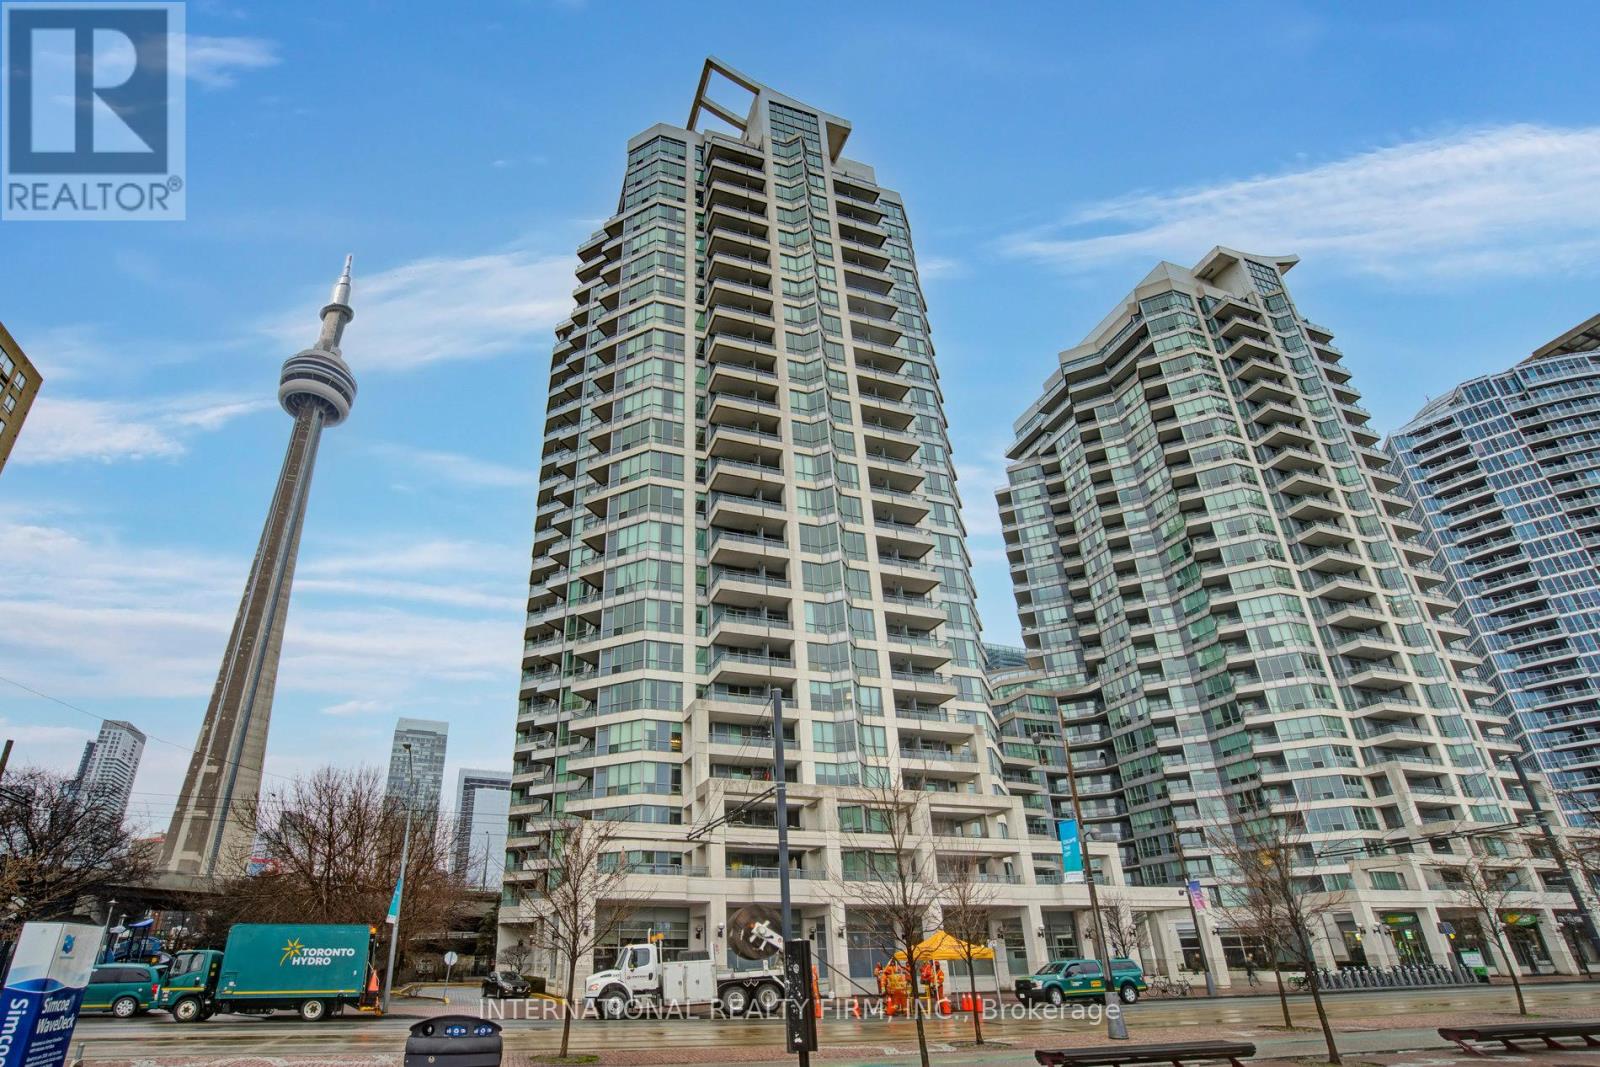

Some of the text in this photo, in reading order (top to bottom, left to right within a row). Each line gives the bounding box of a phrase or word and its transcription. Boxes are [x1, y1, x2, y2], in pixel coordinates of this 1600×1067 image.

[302, 947, 355, 957] TORONTO
[291, 957, 331, 966] HYDRO
[41, 996, 71, 1014] Simcoe
[36, 1015, 76, 1035] WaveDeck
